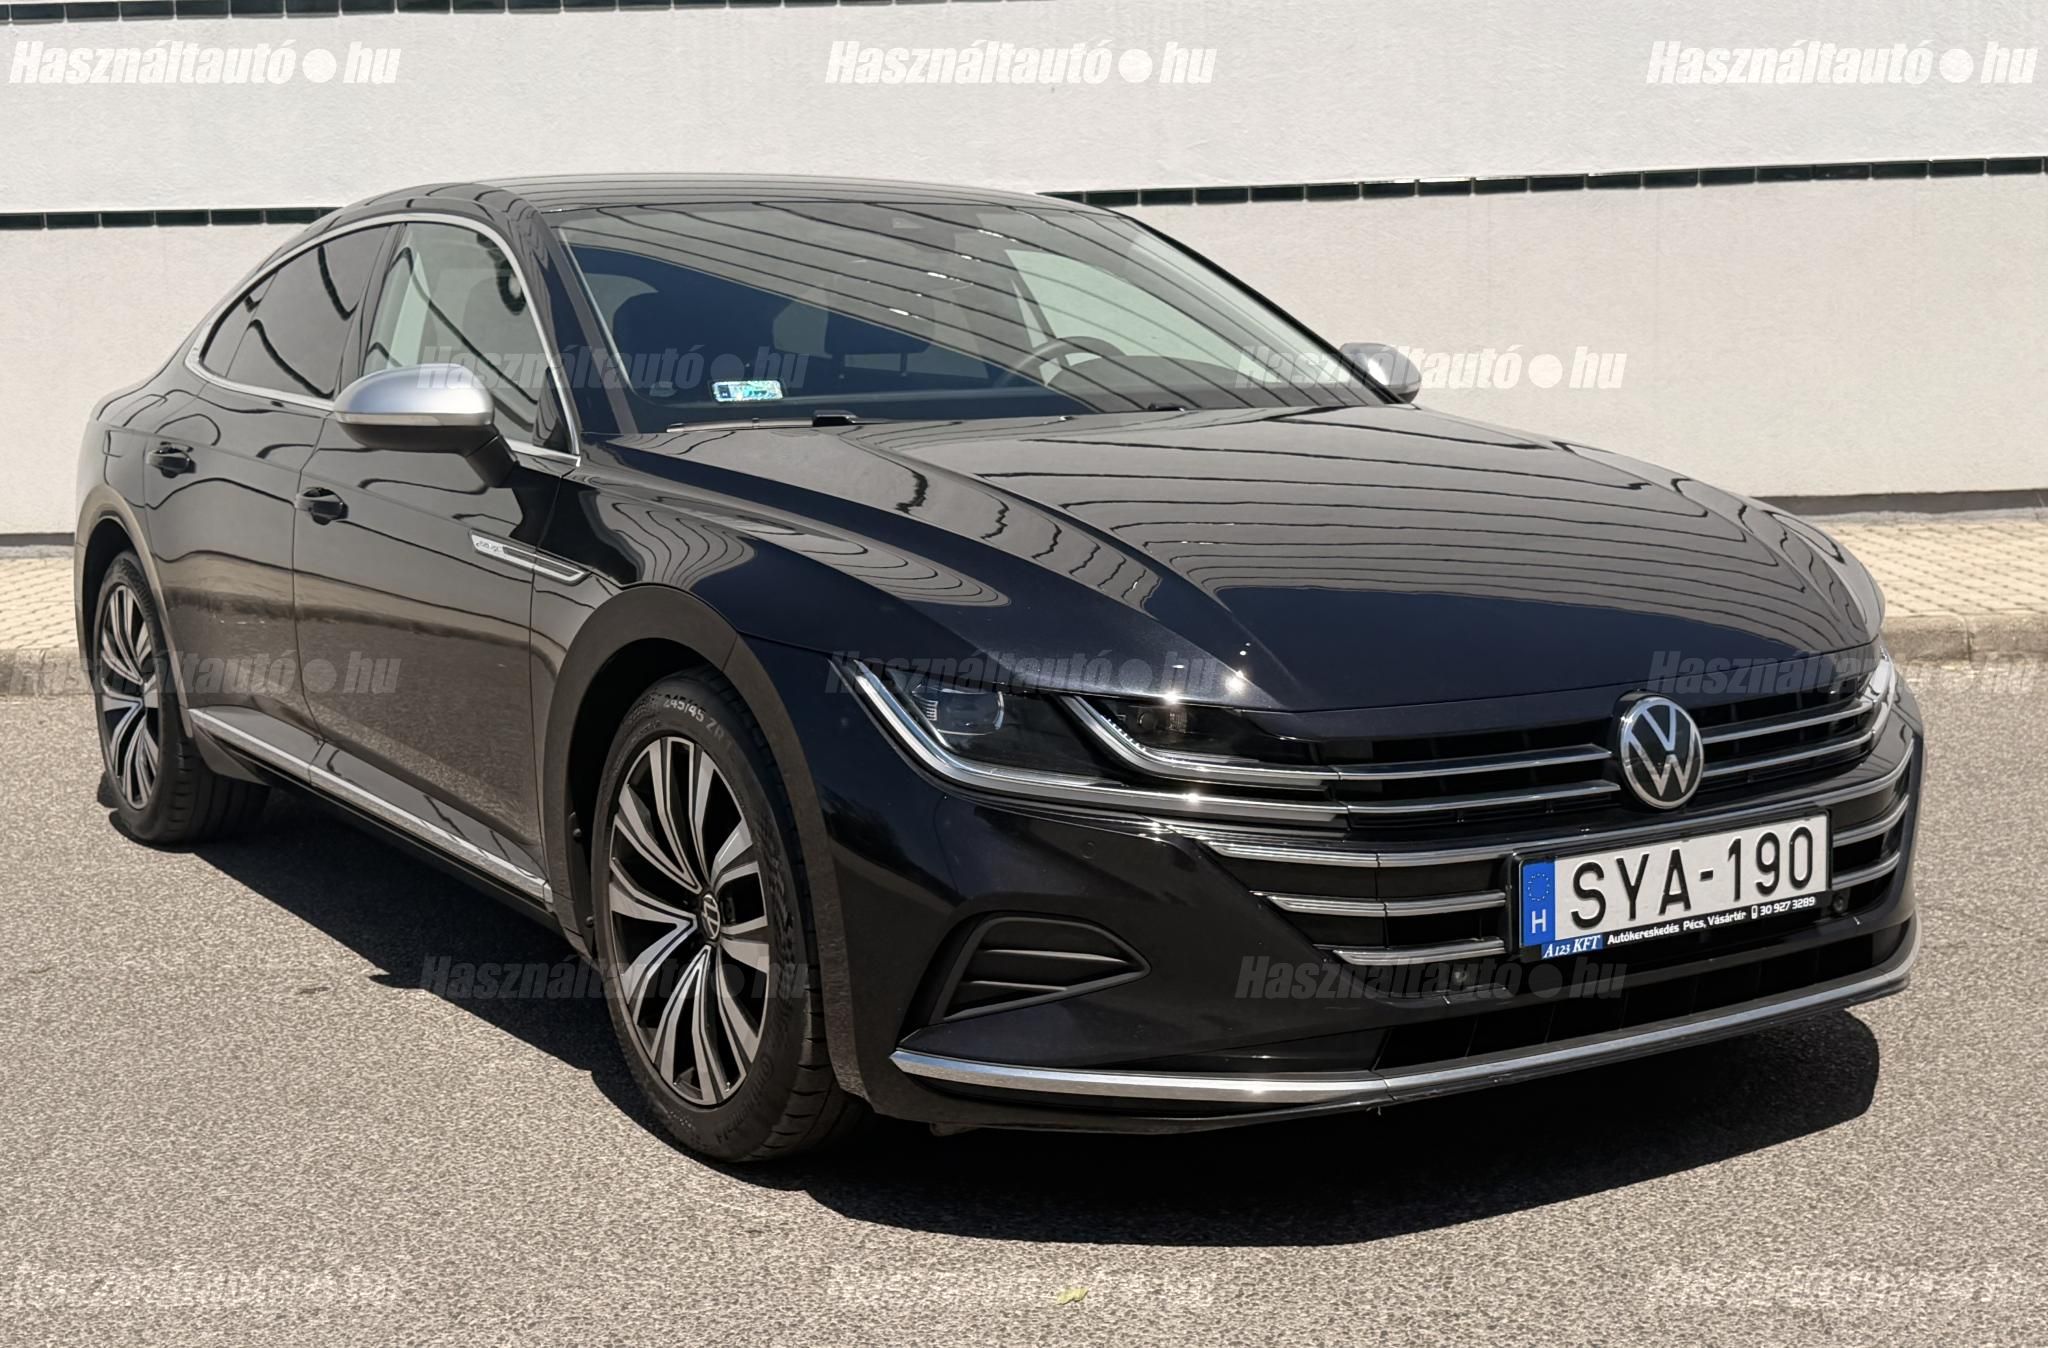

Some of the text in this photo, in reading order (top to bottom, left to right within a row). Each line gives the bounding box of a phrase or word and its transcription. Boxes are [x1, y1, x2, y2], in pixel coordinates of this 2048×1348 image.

[1571, 826, 1814, 929] SYA-190
[1531, 909, 1547, 934] H
[1572, 935, 1600, 953] KFT
[1607, 923, 1680, 945] Autókereskedés
[1683, 919, 1706, 932] Pécs,
[1707, 911, 1747, 926] Vásártér
[1760, 904, 1772, 916] 30
[1773, 900, 1791, 912] 927
[1792, 896, 1816, 909] 3289
